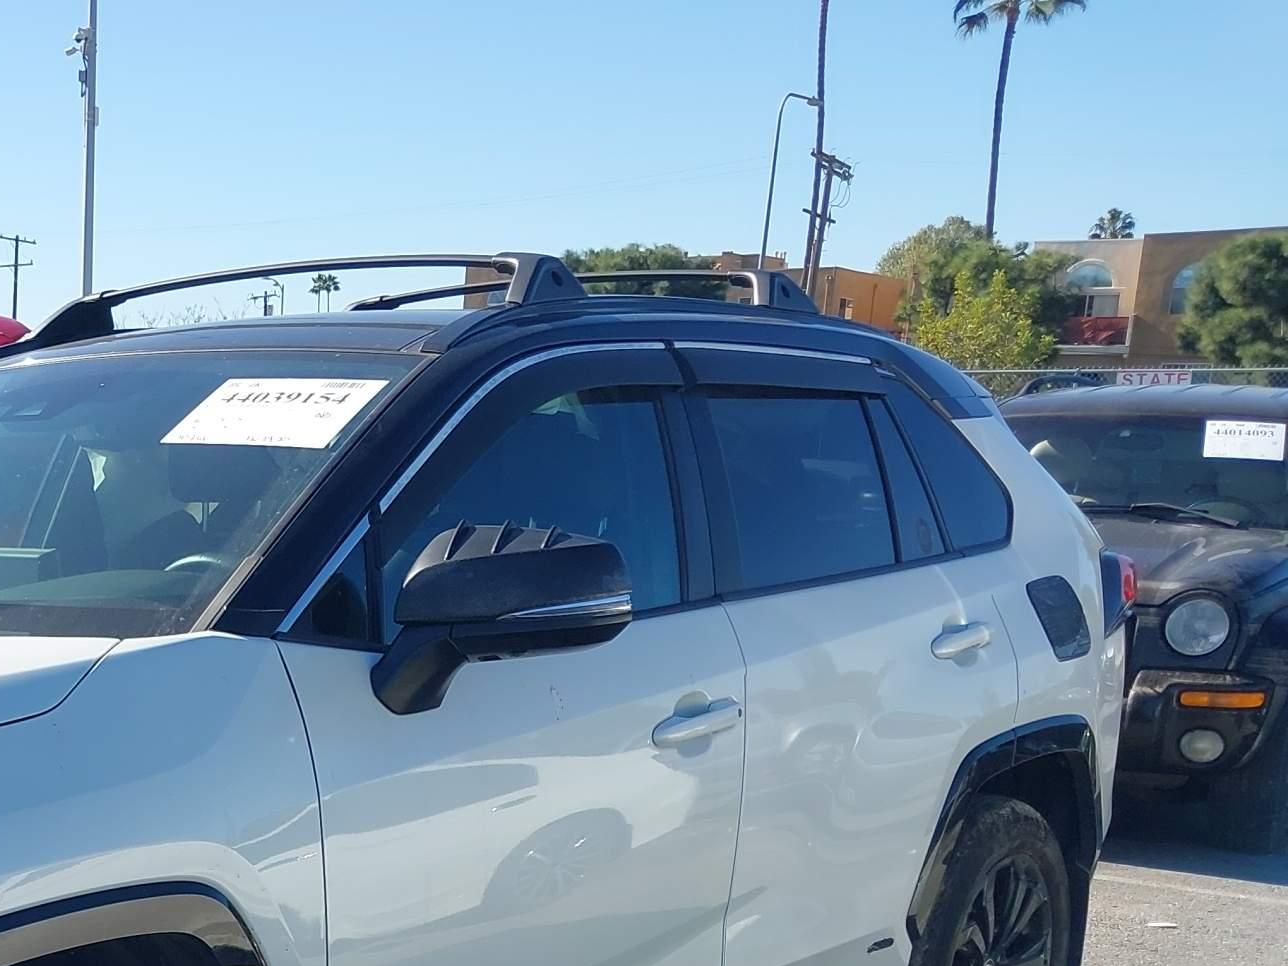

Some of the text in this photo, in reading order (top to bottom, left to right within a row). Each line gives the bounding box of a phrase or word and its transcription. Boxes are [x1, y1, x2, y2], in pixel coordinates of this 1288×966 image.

[1121, 371, 1190, 385] STATE
[221, 391, 352, 405] 44039154
[1212, 428, 1276, 439] 44014093
